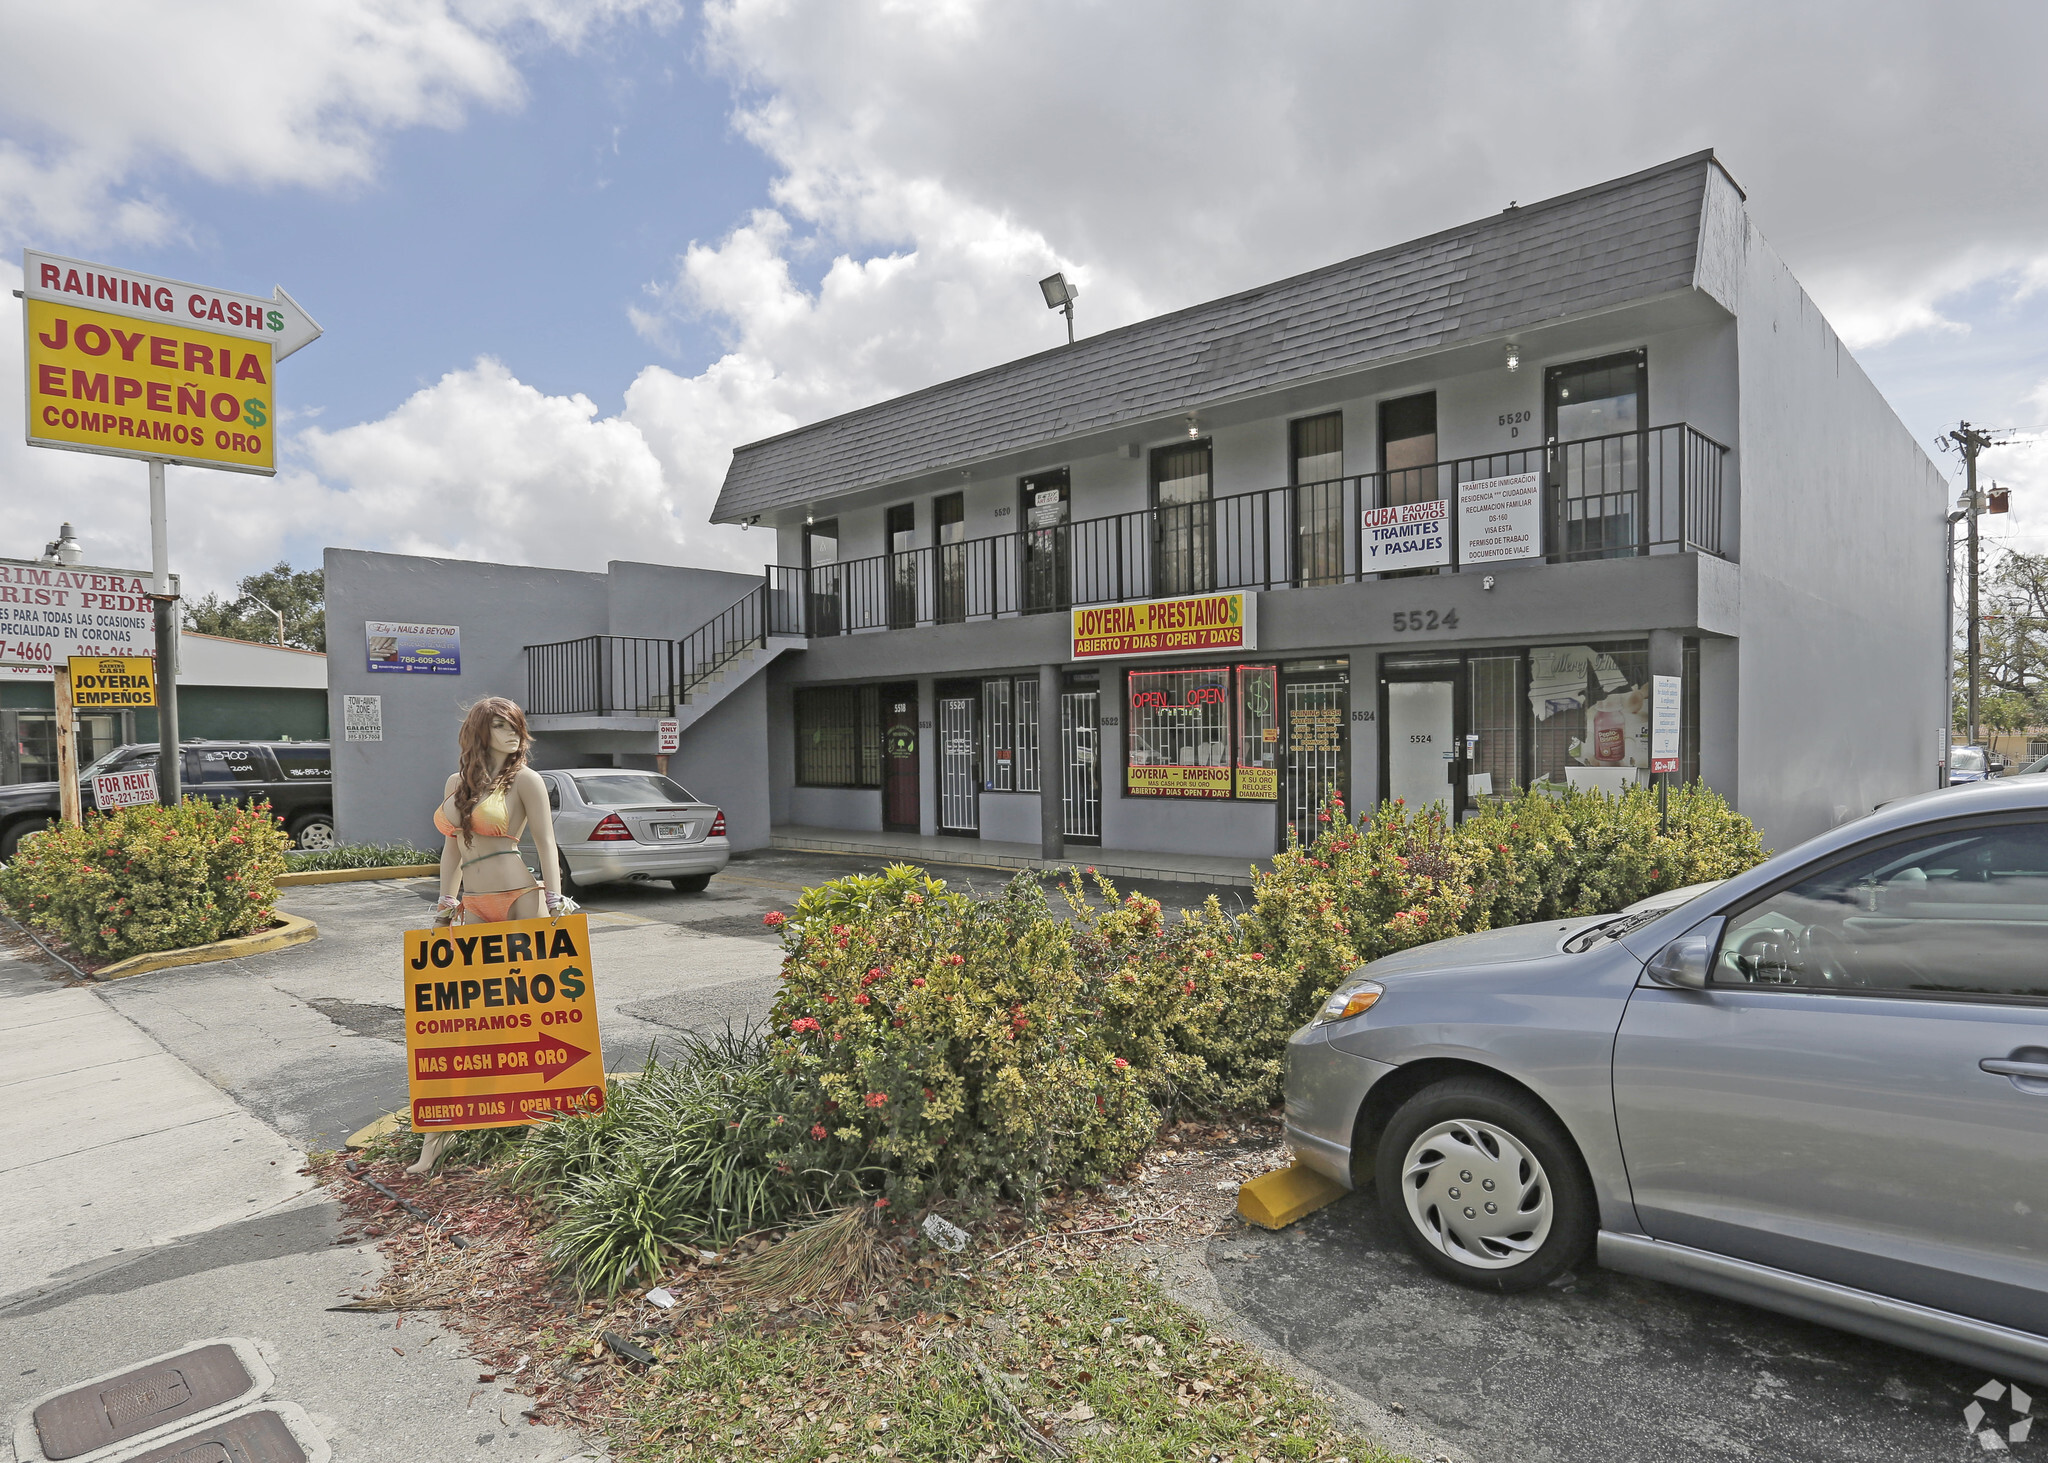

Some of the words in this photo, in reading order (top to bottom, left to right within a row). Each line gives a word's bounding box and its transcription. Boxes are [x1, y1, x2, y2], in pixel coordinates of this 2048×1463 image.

[40, 262, 174, 312] RAINING
[187, 293, 285, 332] CASH$
[38, 317, 267, 385] JOYERIA
[38, 363, 267, 429] EMPEÑO$
[1498, 410, 1531, 426] 5520
[42, 405, 204, 446] COMPRAMOS
[214, 430, 262, 454] ORO
[1512, 427, 1519, 438] D
[1489, 481, 1498, 489] DE
[1460, 492, 1494, 504] RESIDENCIA
[1502, 486, 1538, 498] CIUDADANIA
[994, 507, 1011, 518] 5520
[1364, 507, 1398, 527] CUBA
[1402, 500, 1445, 514] PAQUETE
[1465, 503, 1506, 514] RECLAMACION
[1506, 499, 1532, 509] FAMILIAR
[1402, 509, 1446, 522] ENVIOS
[1372, 521, 1439, 541] TRAMITES
[1484, 526, 1498, 535] VISA
[1498, 524, 1513, 533] ESTA
[1370, 545, 1378, 557] Y
[1385, 537, 1443, 555] PASAJES
[1469, 538, 1494, 547] PERMISO
[1494, 536, 1502, 545] DE
[1502, 534, 1530, 543] TRABAJO
[1469, 549, 1505, 559] DOCUMENTO
[1505, 547, 1512, 555] DE
[1513, 545, 1530, 554] VIAJE
[13, 609, 39, 622] PARA
[43, 611, 73, 624] TODAS
[77, 614, 93, 625] LAS
[96, 616, 145, 629] OCASIONES
[1078, 607, 1136, 637] JOYERIA
[1148, 594, 1238, 631] PRESTAMO$
[1393, 608, 1459, 632] 5524
[1, 623, 59, 637] PECIALIDAD
[64, 627, 78, 639] EN
[82, 629, 131, 642] CORONAS
[397, 625, 418, 634] NAILS
[426, 627, 456, 636] BEYOND
[1077, 638, 1121, 653] ABIERTO
[1123, 636, 1129, 650] 7
[1132, 634, 1157, 649] DIAS
[1166, 632, 1197, 647] OPEN
[1200, 631, 1206, 644] 7
[1210, 628, 1240, 643] DAYS
[400, 656, 456, 665] 786-609-3845
[75, 675, 150, 689] JOYERIA
[76, 689, 152, 704] EMPEÑOS
[1132, 691, 1167, 708] OPEN
[1187, 688, 1225, 705] OPEN
[356, 705, 371, 714] ZONE
[949, 701, 966, 710] 5520
[1290, 709, 1320, 717] RAINING
[1321, 708, 1342, 717] CASH
[1101, 717, 1119, 726] 5522
[1352, 710, 1375, 721] 5524
[1410, 735, 1432, 744] 5524
[1130, 768, 1169, 780] JOYERIA
[1239, 769, 1254, 777] MAS
[1256, 769, 1276, 777] CASH
[1259, 776, 1273, 784] ORO
[97, 777, 121, 794] FOR
[123, 773, 150, 791] RENT
[1159, 788, 1164, 796] 7
[1166, 788, 1182, 796] DIAS
[1184, 789, 1202, 797] OPEN
[1204, 789, 1210, 797] 7
[1211, 789, 1230, 798] DAYS
[1239, 790, 1277, 799] DIAMANTES
[411, 928, 578, 971] JOYERIA
[414, 964, 586, 1013] EMPEÑO$
[415, 1013, 532, 1035] COMPRAMOS
[540, 1008, 583, 1026] ORO
[418, 1057, 447, 1073] MAS
[453, 1053, 492, 1071] CASH
[498, 1051, 529, 1068] POR
[535, 1048, 568, 1066] ORO
[418, 1103, 463, 1119] ABIERTO
[467, 1103, 474, 1117] 7
[479, 1101, 505, 1116] DIAS
[519, 1097, 552, 1113] OPEN
[555, 1096, 562, 1110] 7
[566, 1093, 598, 1109] DAYS
